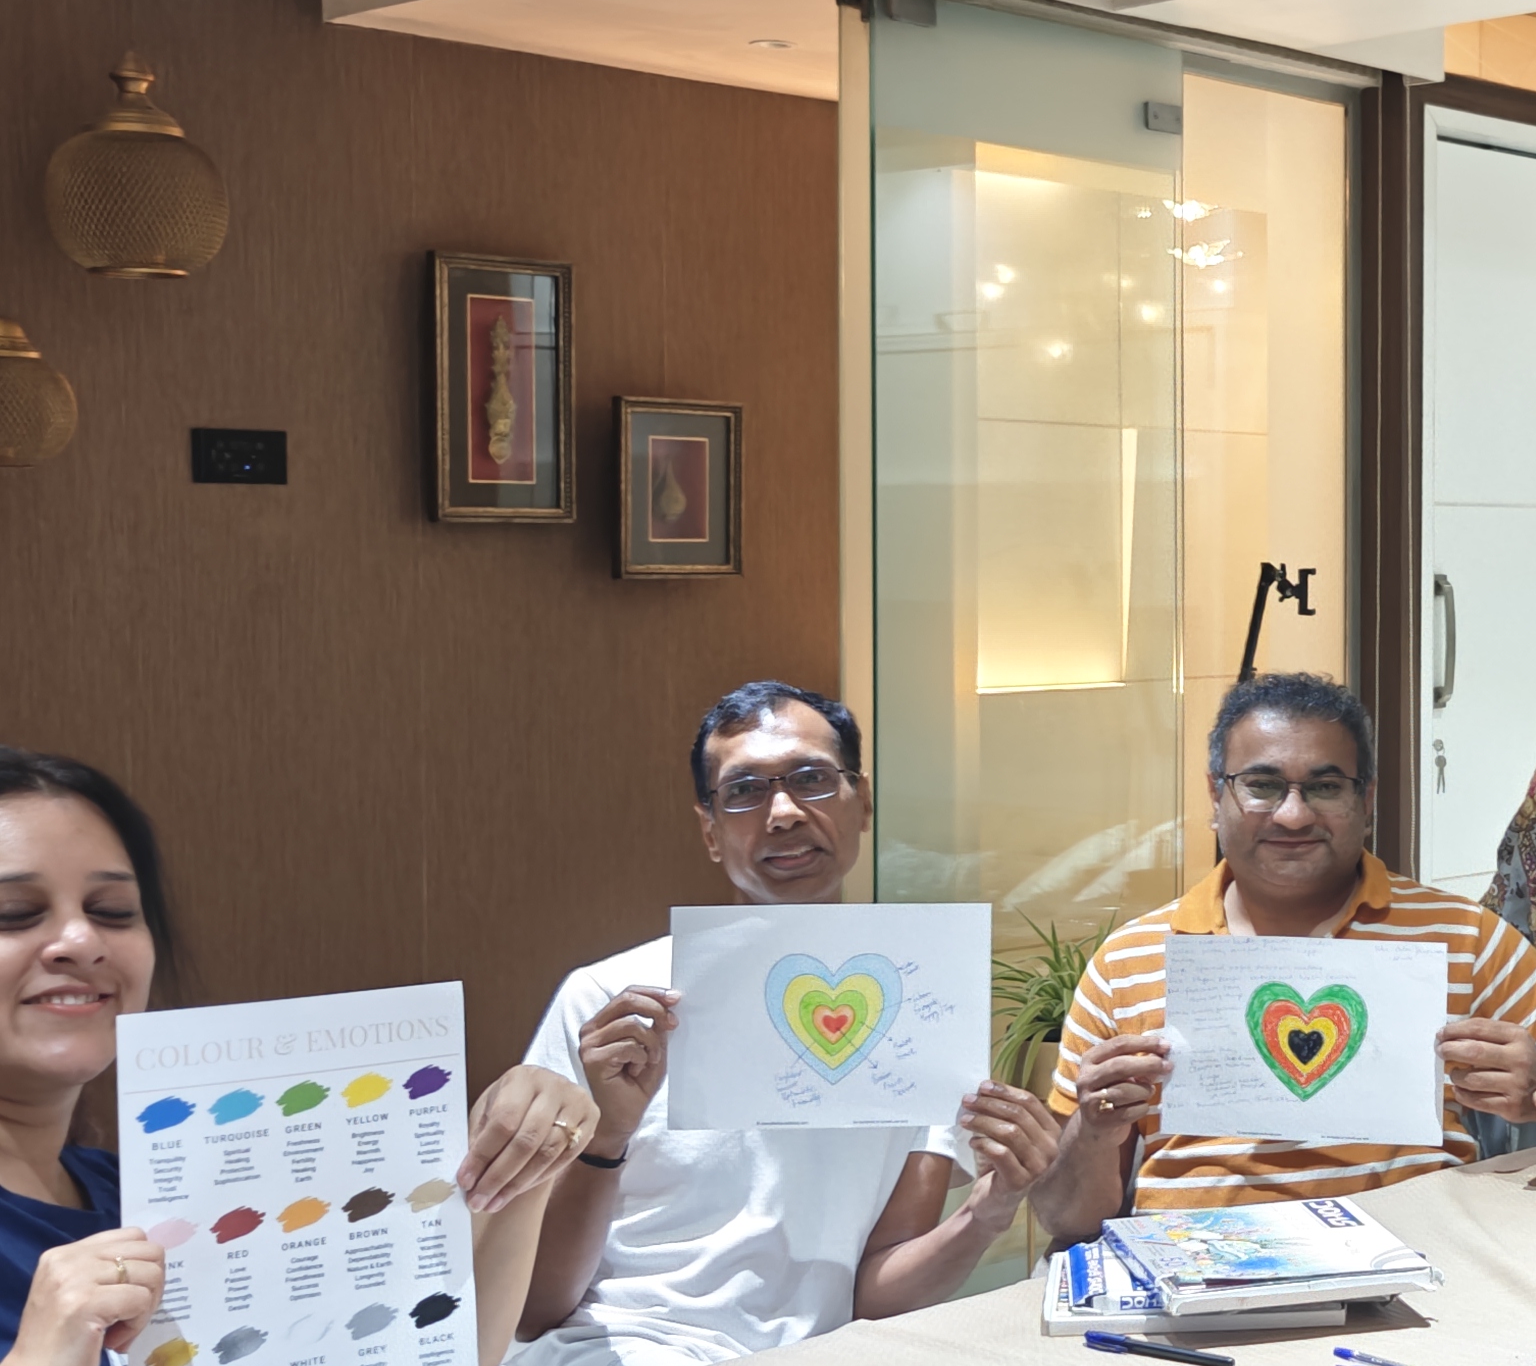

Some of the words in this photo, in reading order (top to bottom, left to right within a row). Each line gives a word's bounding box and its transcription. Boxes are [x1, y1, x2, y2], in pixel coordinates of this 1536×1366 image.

[135, 1037, 264, 1072] COLOUR
[274, 1034, 297, 1056] &
[306, 1015, 450, 1054] EMOTIONS
[409, 1104, 448, 1116] PURPLE
[345, 1113, 389, 1126] YELLOW
[285, 1122, 322, 1134] GREEN
[203, 1128, 270, 1144] TURQUOISE
[151, 1139, 183, 1151] BLUE
[1308, 1200, 1359, 1227] DOMS
[421, 1219, 442, 1228] TAN
[349, 1227, 389, 1241] BROWN
[281, 1236, 327, 1251] ORANGE
[227, 1249, 249, 1260] RED
[1121, 1297, 1165, 1309] DOM
[418, 1332, 455, 1346] BLACK
[358, 1344, 388, 1357] GREY
